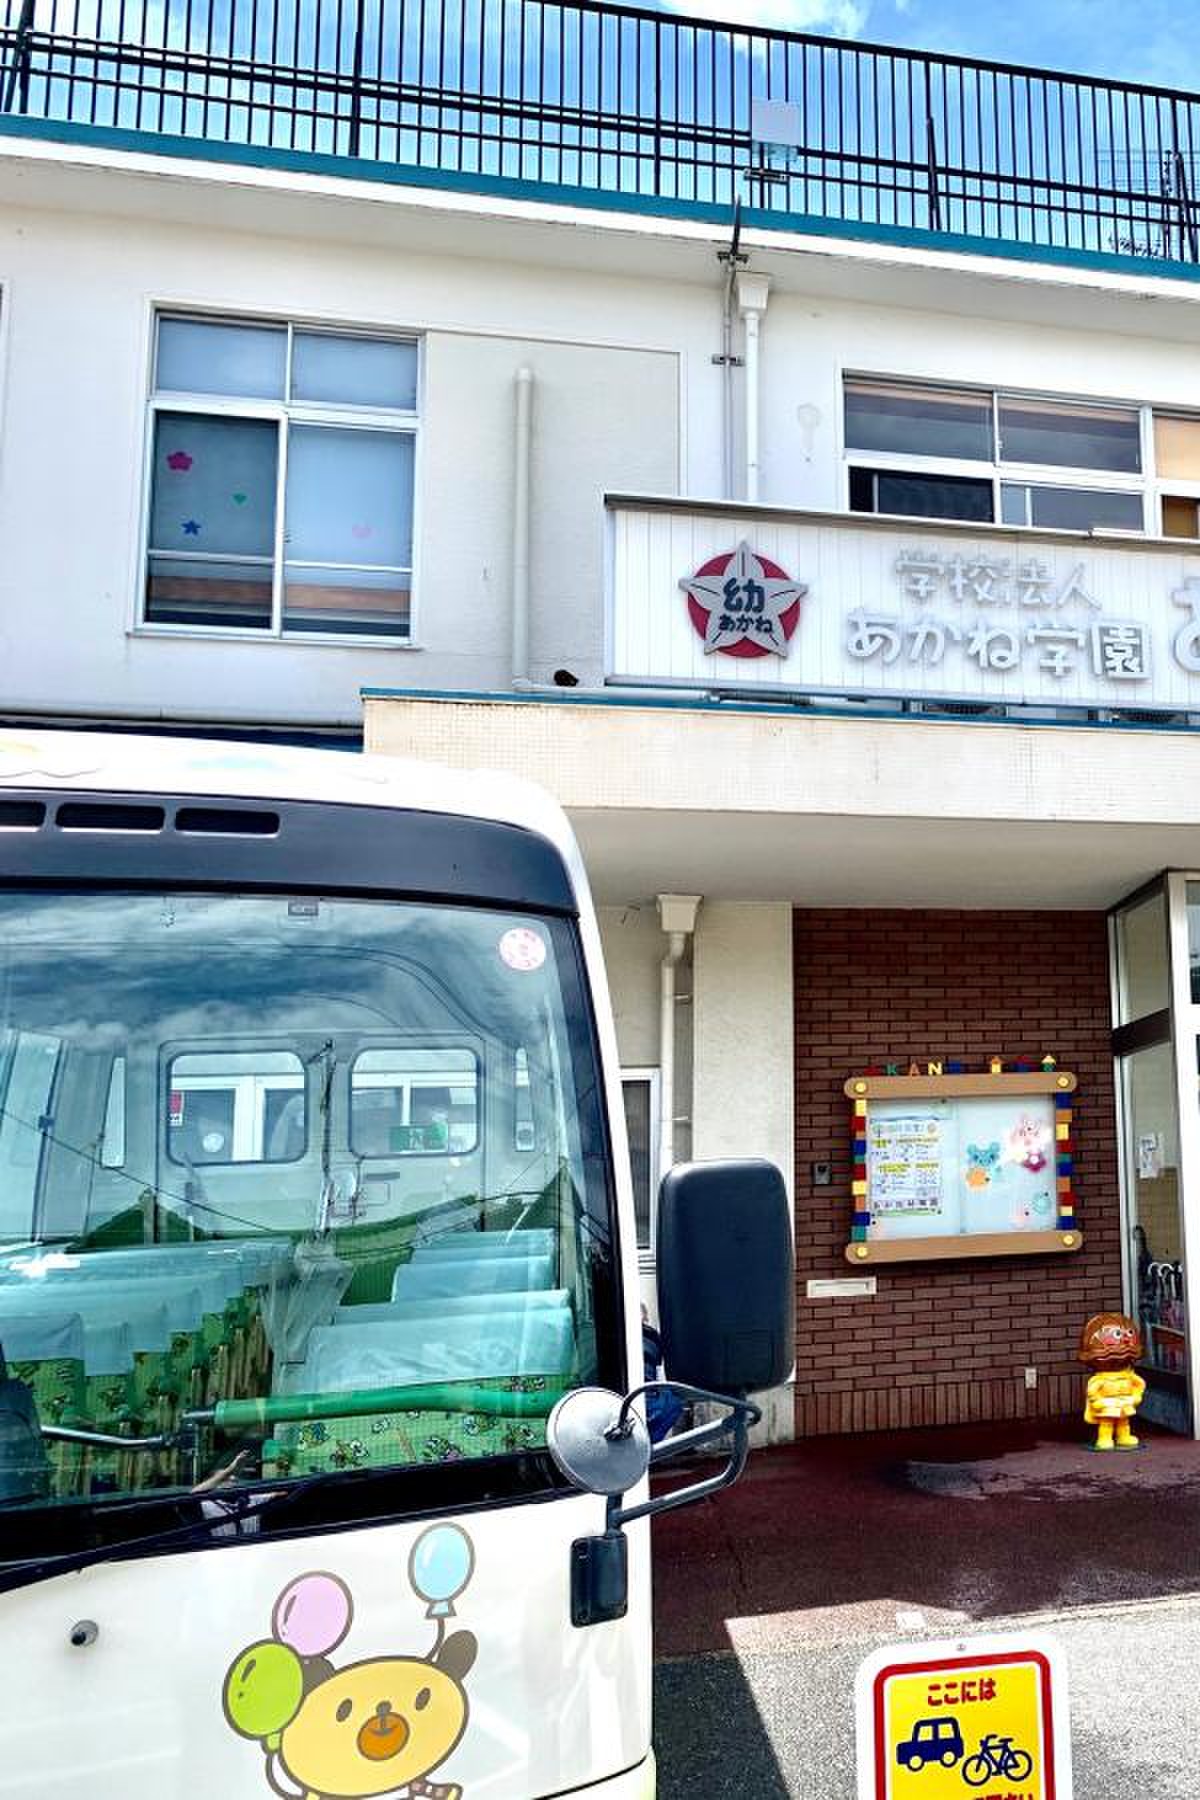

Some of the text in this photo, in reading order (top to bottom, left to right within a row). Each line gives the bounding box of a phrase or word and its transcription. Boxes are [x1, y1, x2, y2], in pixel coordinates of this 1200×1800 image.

[723, 578, 765, 613] 幼
[896, 547, 1104, 609] 学校法人
[719, 614, 774, 633] あかね
[846, 607, 1152, 679] あかね学園
[928, 1678, 997, 1706] ここには
